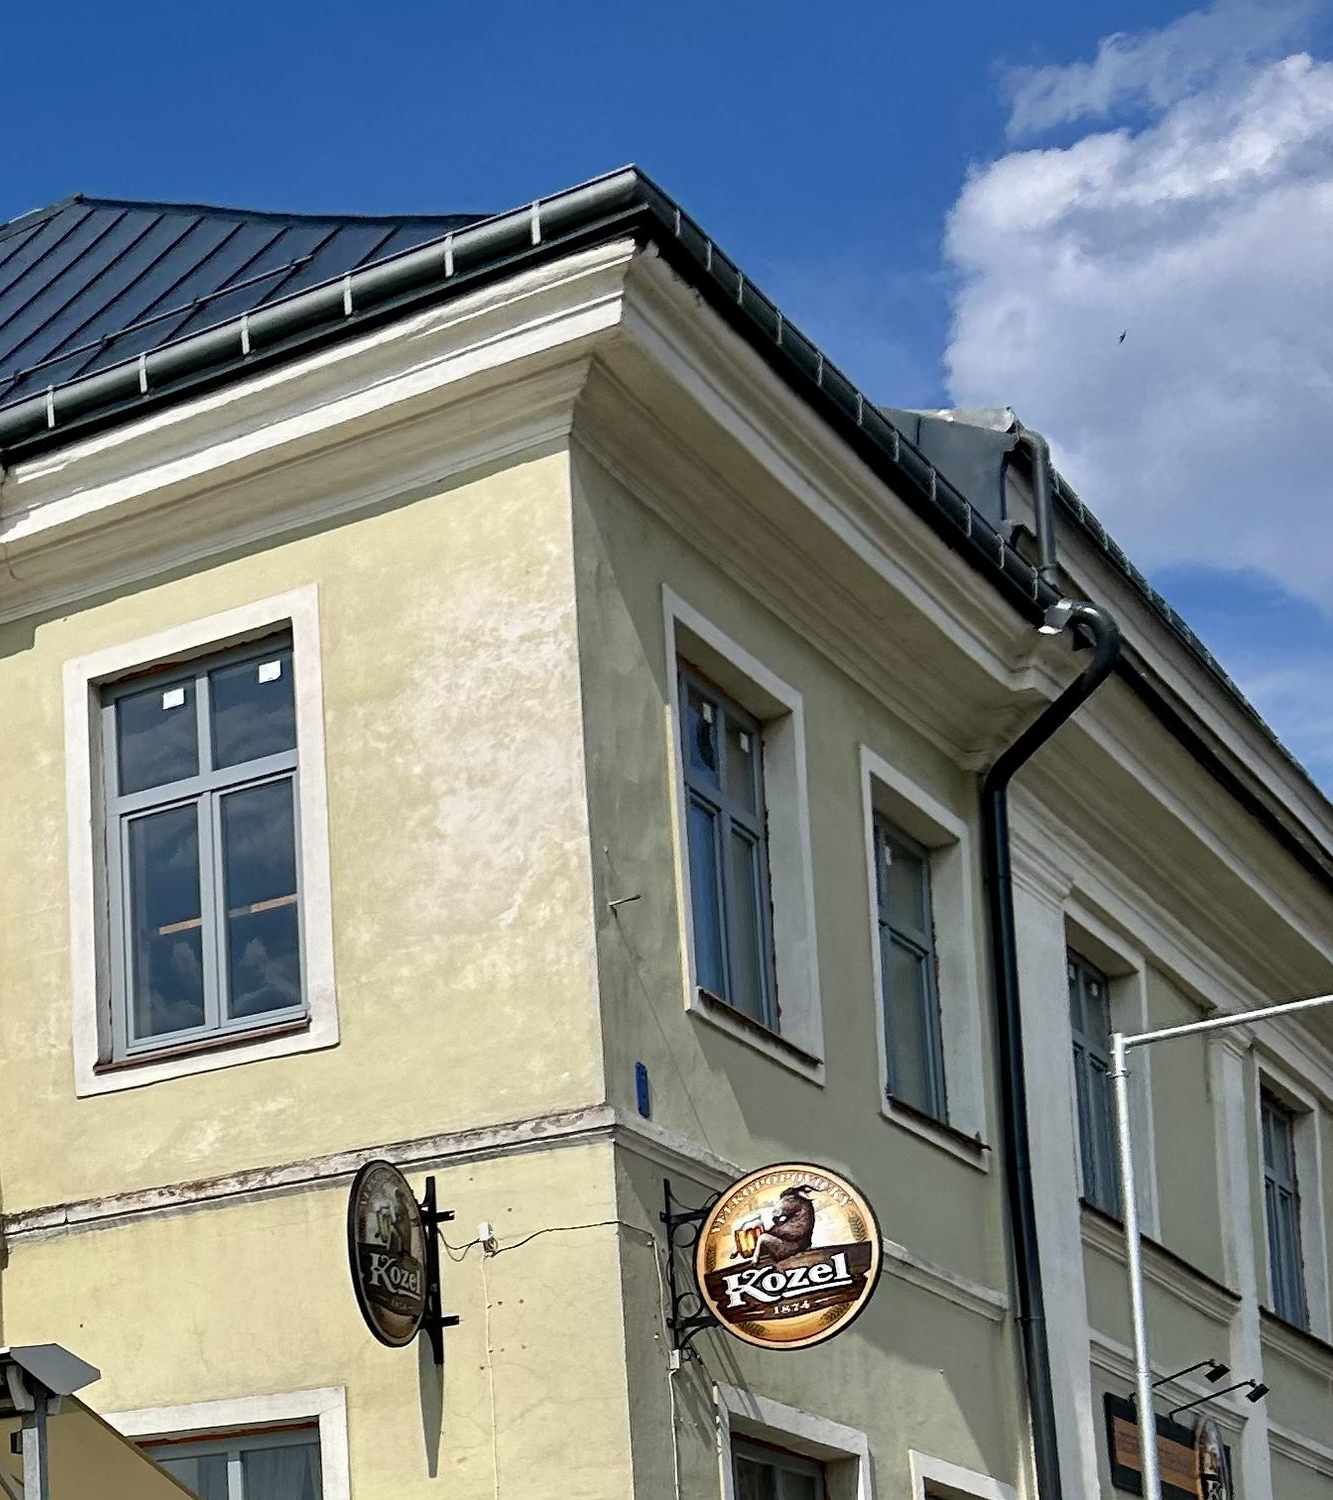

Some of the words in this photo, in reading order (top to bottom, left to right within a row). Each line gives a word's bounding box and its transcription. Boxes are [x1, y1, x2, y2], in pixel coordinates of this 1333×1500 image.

[369, 1252, 422, 1296] Kozel
[723, 1252, 852, 1309] Kozel
[773, 1302, 811, 1315] 1874
